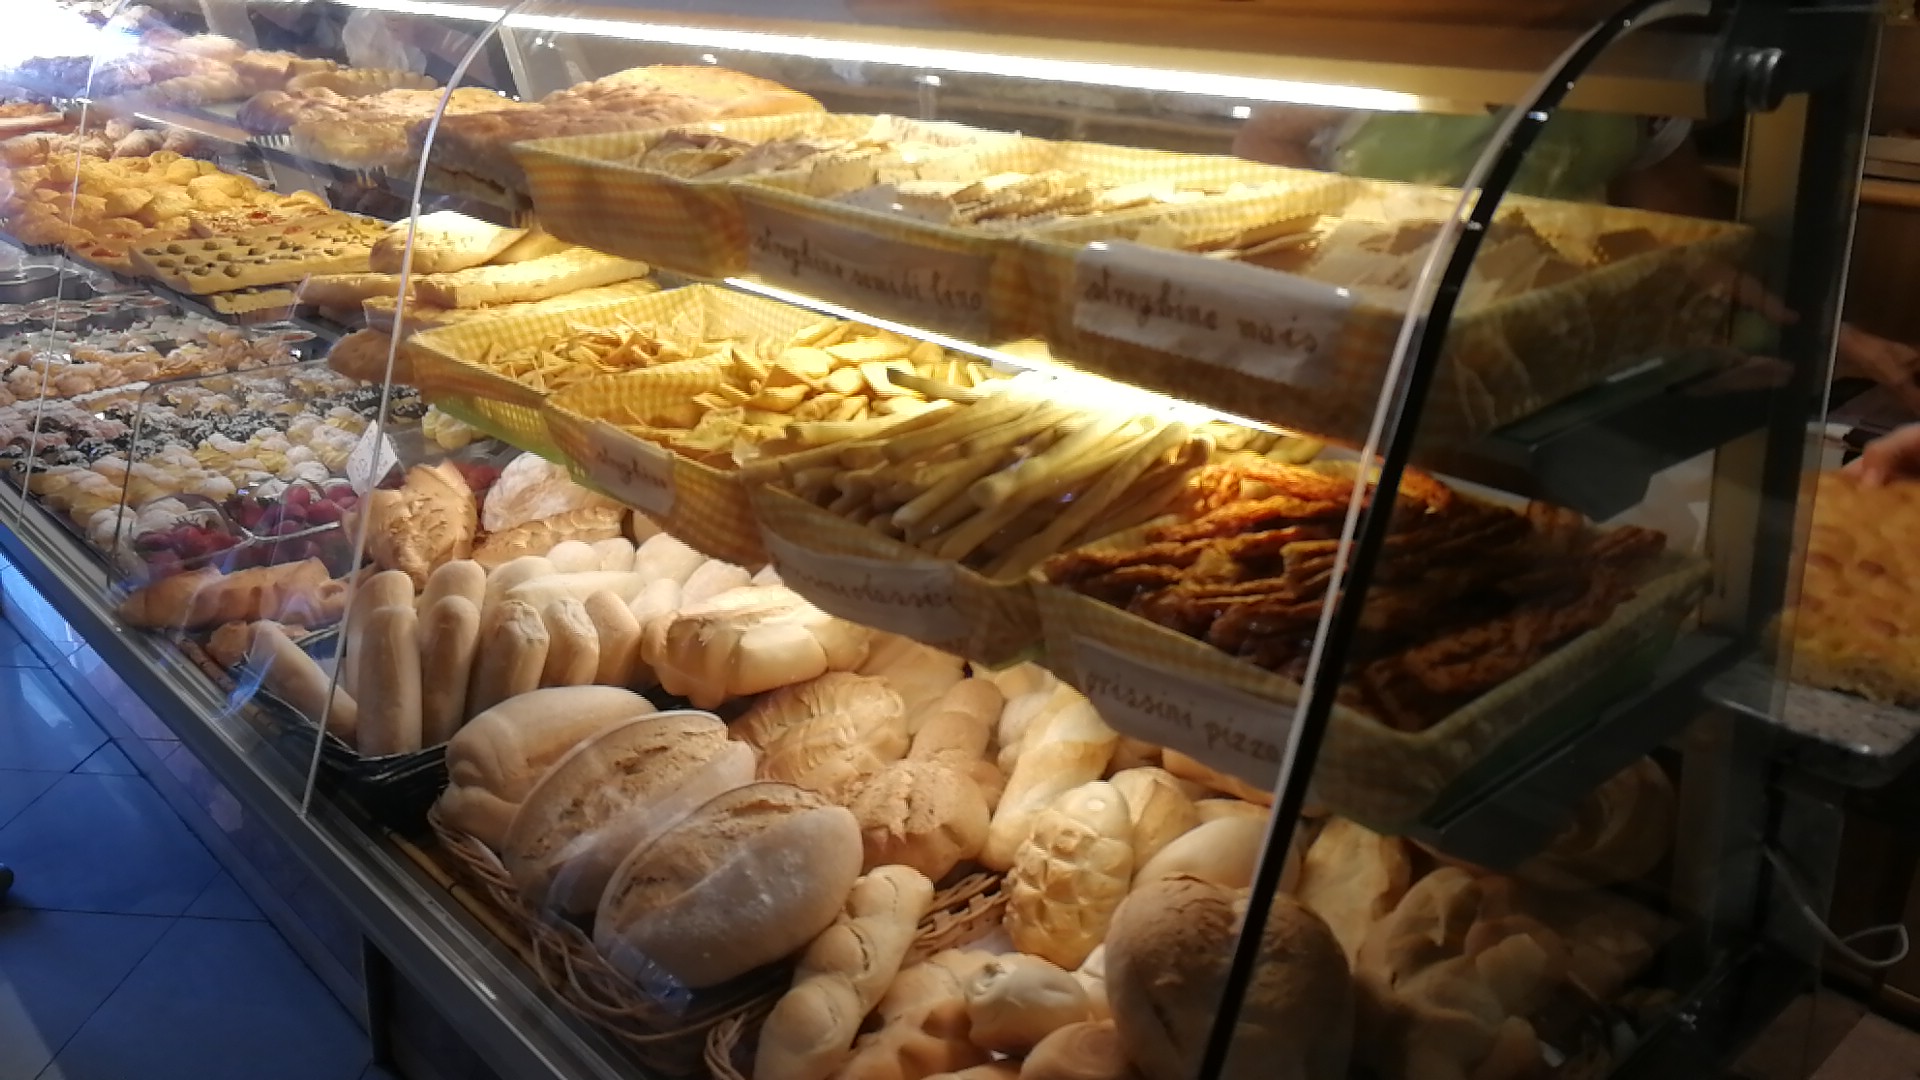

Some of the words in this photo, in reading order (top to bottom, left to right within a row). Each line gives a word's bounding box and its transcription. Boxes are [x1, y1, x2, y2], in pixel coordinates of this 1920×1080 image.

[1084, 265, 1217, 330] streghine
[1237, 314, 1318, 353] mais
[1086, 670, 1192, 730] grissini
[1204, 716, 1281, 763] pizza
